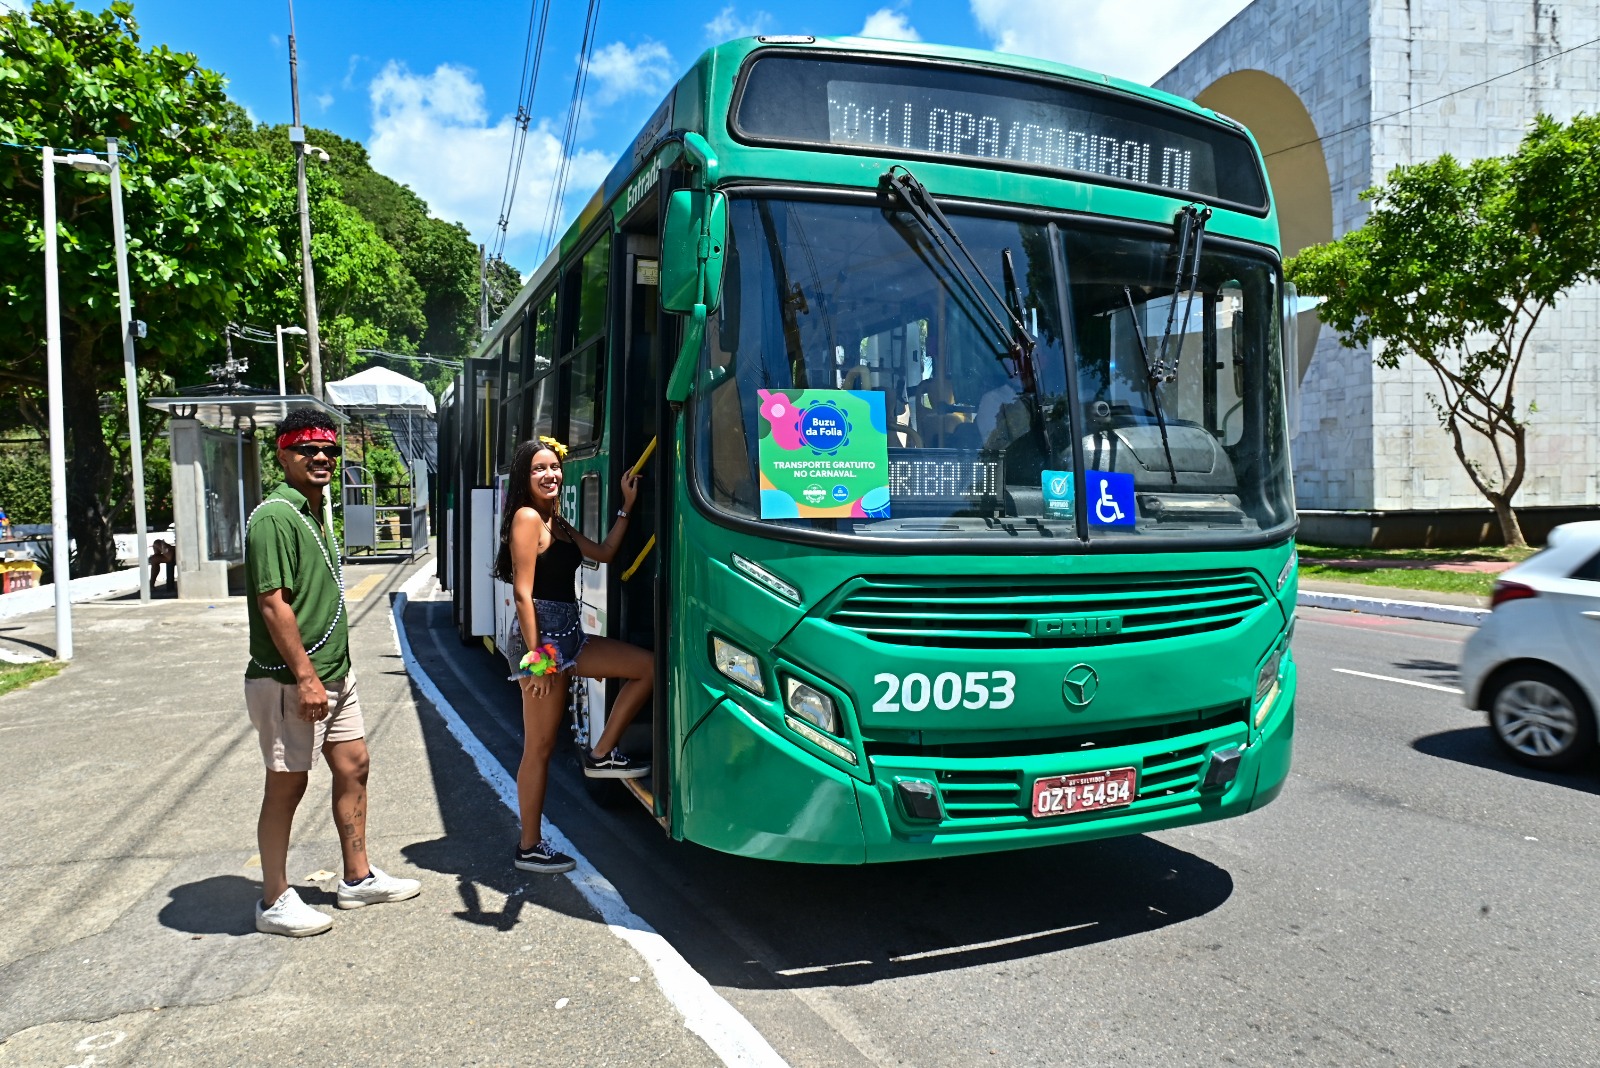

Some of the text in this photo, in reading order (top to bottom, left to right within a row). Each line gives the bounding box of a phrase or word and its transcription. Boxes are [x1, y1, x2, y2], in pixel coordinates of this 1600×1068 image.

[812, 417, 836, 427] Buzu
[805, 427, 843, 436] da Folia
[773, 461, 876, 469] TRANSPORTE GRATUITO
[793, 470, 808, 478] NO
[1037, 616, 1121, 637] CAIO
[872, 670, 1016, 713] 20053
